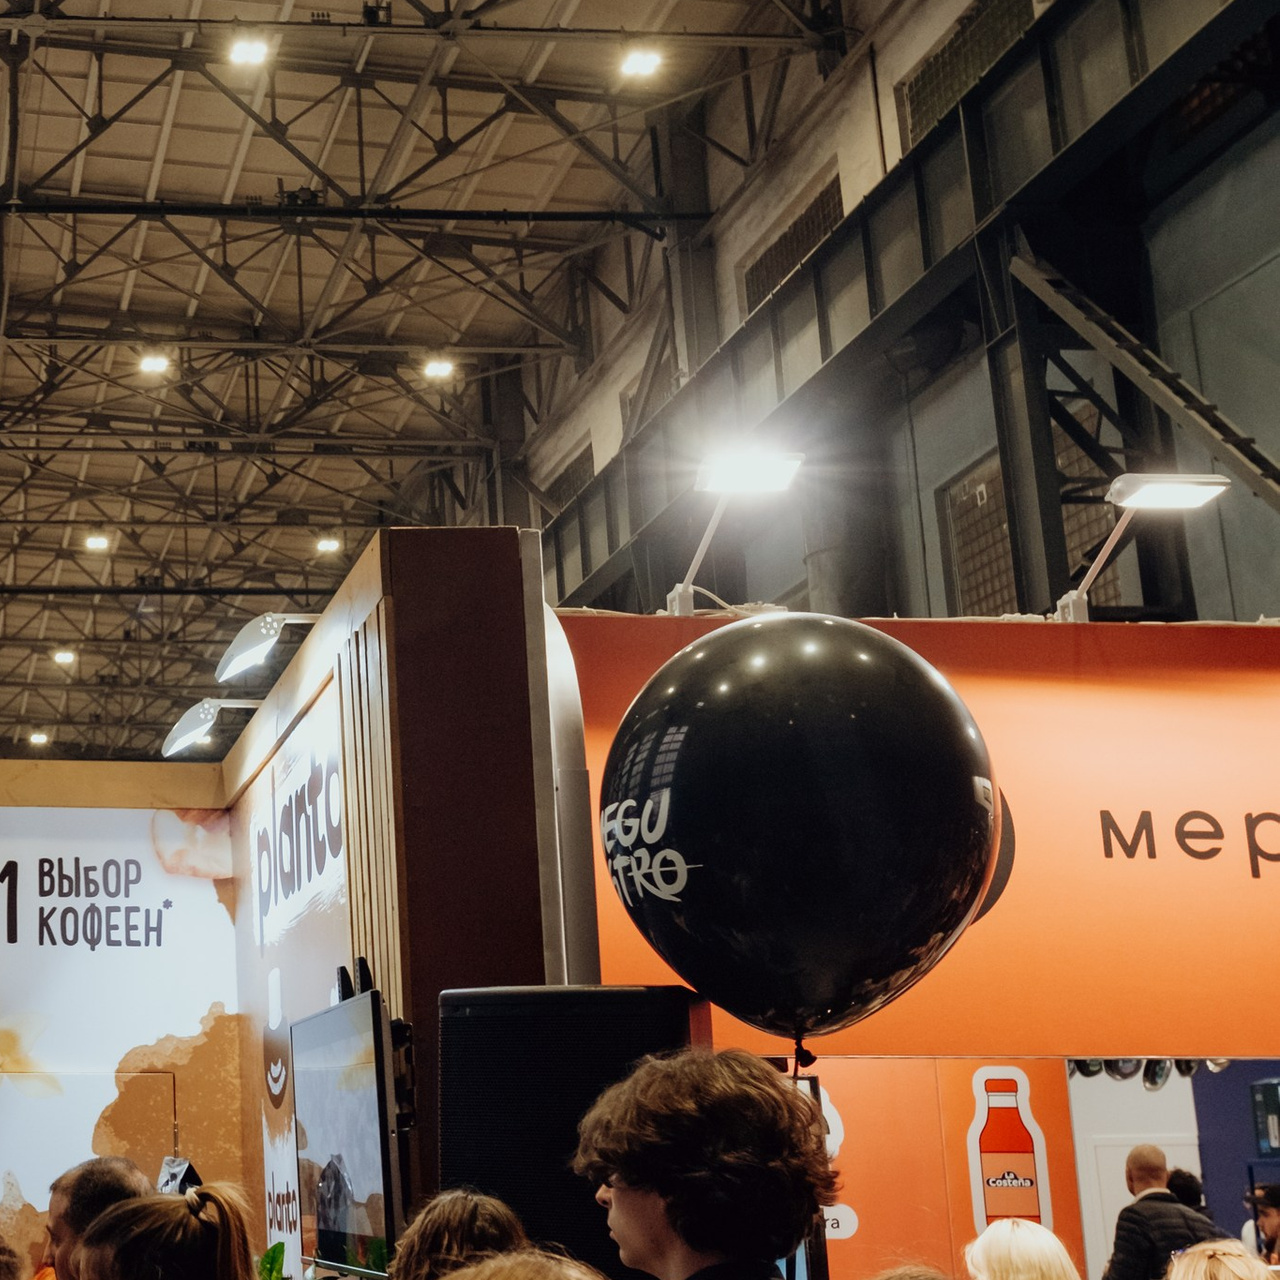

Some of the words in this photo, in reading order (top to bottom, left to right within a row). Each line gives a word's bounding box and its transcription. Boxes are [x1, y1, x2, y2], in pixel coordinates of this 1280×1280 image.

[600, 787, 671, 854] EGU
[38, 857, 142, 898] ВЫБОР
[258, 757, 343, 959] planto
